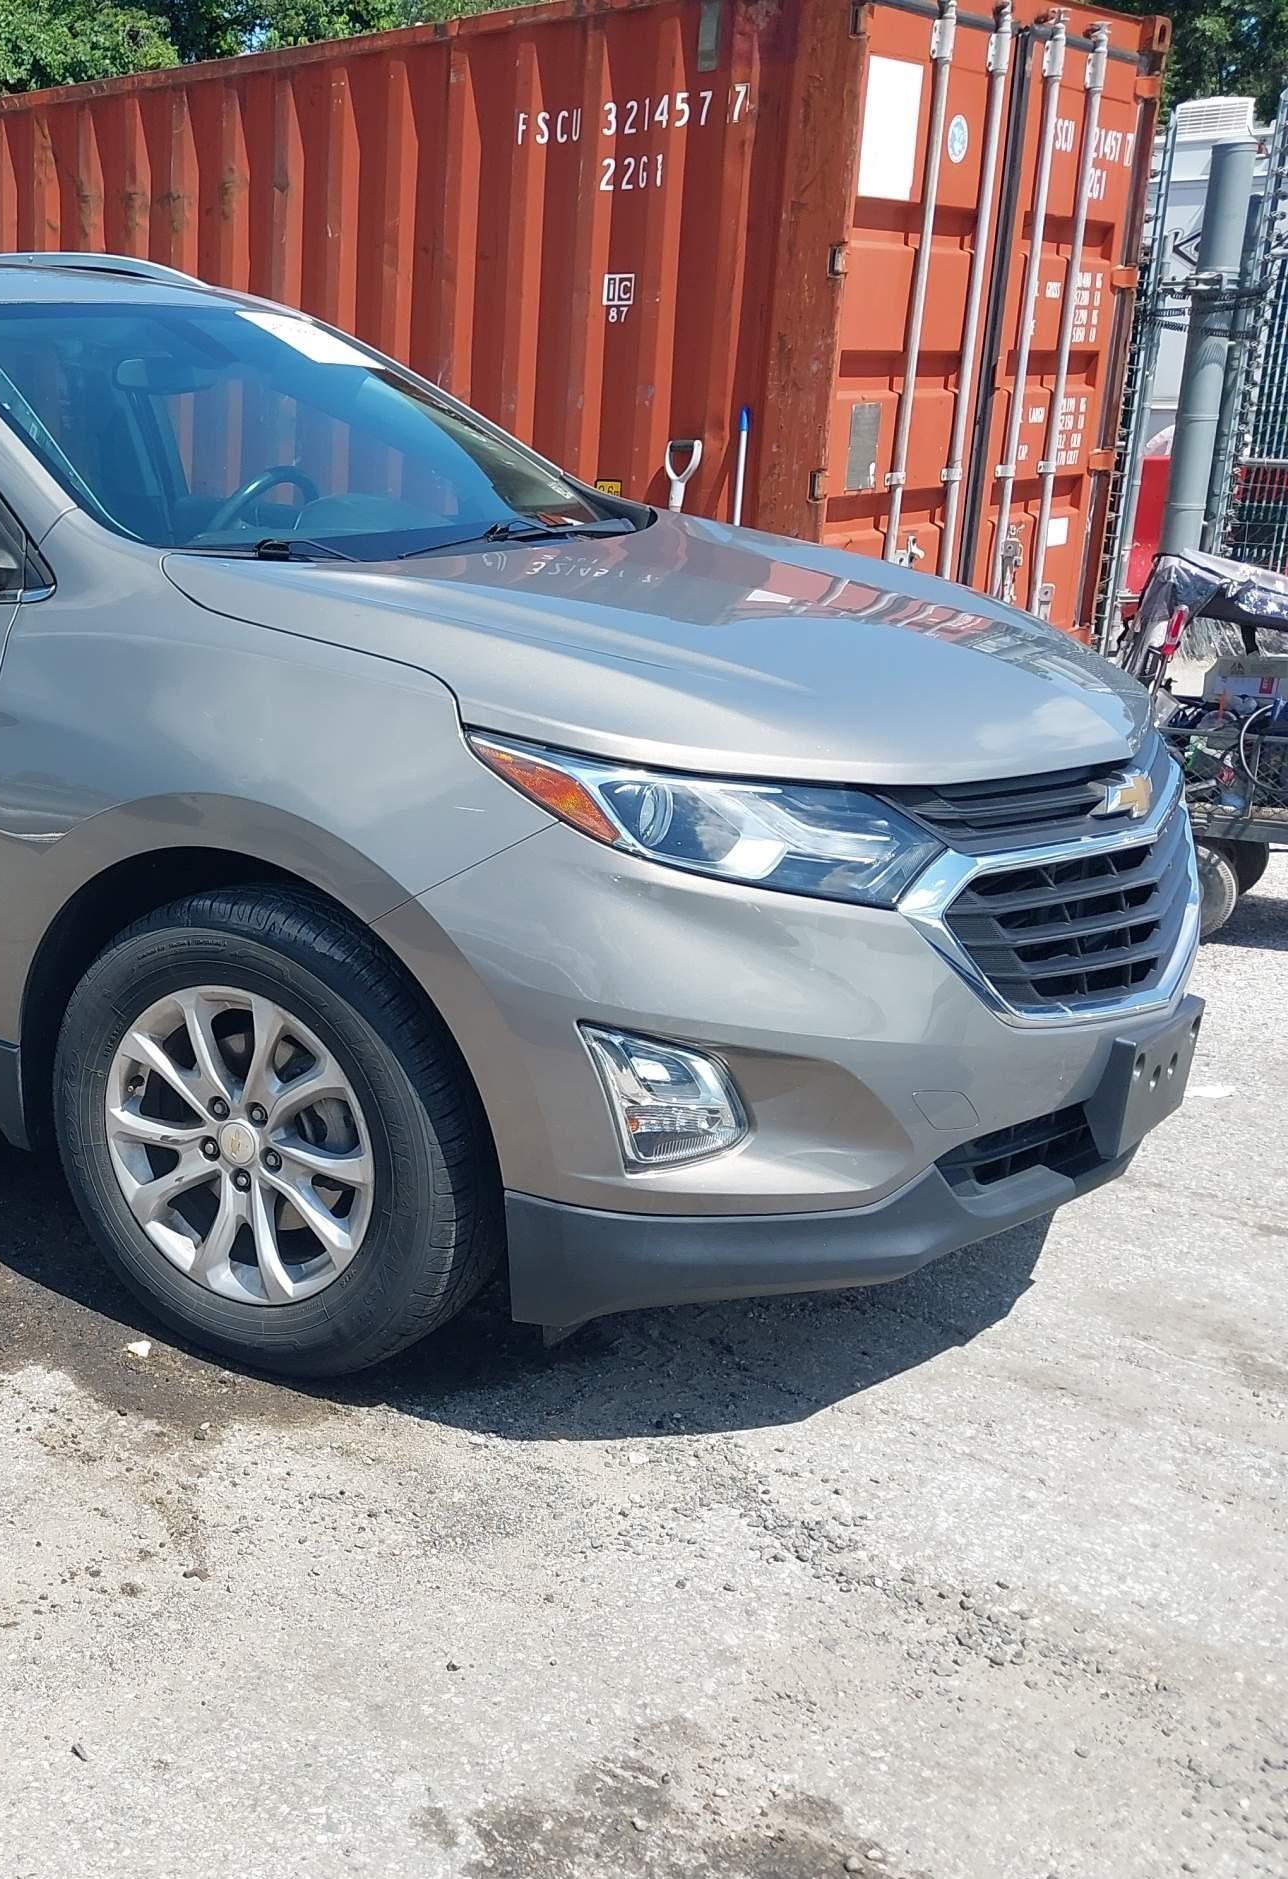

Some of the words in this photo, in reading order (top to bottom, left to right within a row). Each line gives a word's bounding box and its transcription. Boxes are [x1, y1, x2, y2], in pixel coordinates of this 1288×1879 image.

[517, 108, 581, 145] FSCU
[602, 91, 712, 136] 321457
[729, 82, 750, 124] 7
[1052, 117, 1075, 152] SCU
[1092, 126, 1123, 163] 21457
[599, 154, 663, 191] 22G1
[1088, 167, 1107, 200] 2G1
[608, 307, 629, 323] 87
